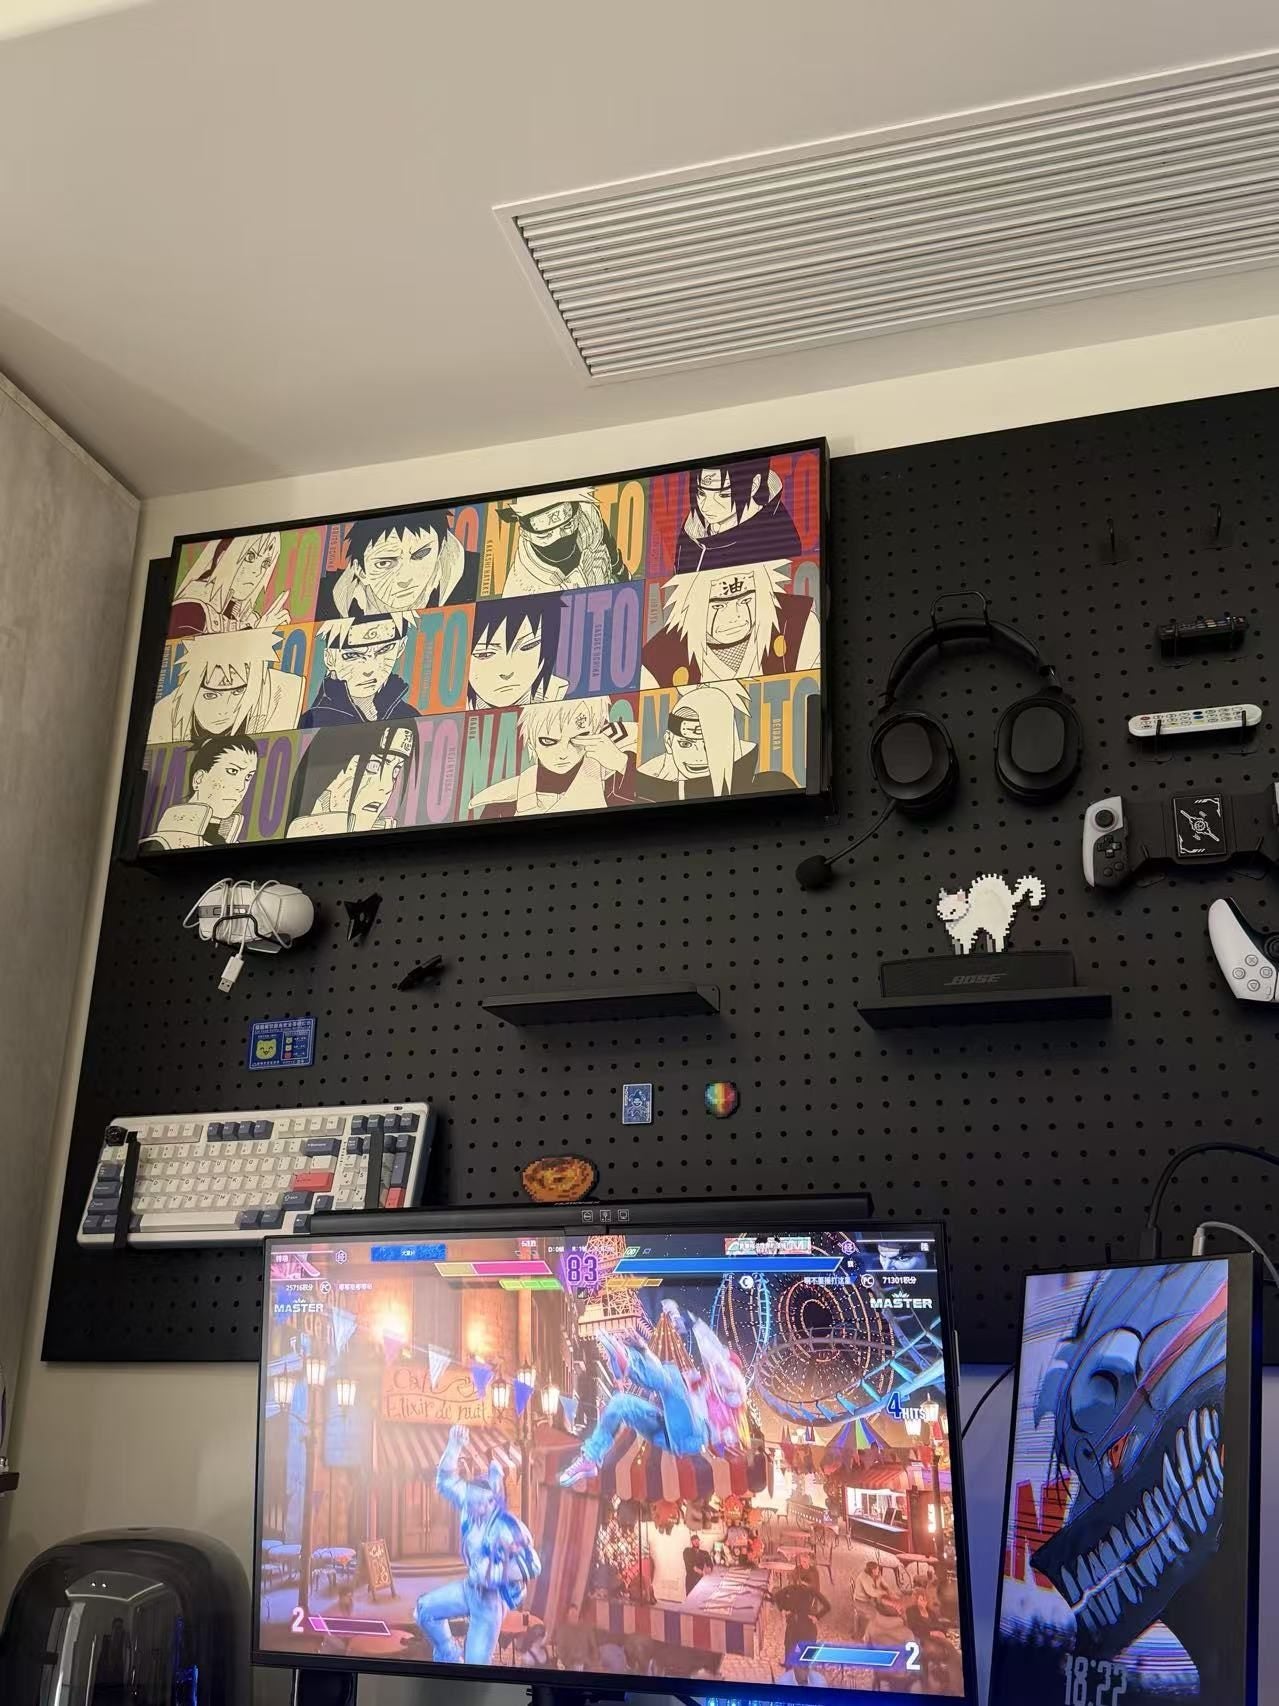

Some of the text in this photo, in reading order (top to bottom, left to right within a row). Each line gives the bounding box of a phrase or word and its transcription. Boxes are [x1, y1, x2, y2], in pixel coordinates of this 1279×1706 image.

[480, 540, 493, 595] KAKASHI HATAKE
[722, 576, 745, 596] 油
[593, 624, 602, 651] SASUKE
[468, 717, 478, 740] GAARA
[771, 718, 782, 750] DEIDARA
[949, 973, 1002, 985] BOSE
[566, 1254, 599, 1286] 83
[273, 1303, 324, 1313] MASTER
[869, 1298, 933, 1309] MASTER
[886, 1391, 927, 1420] 4 HITS
[290, 1606, 305, 1633] 2
[904, 1641, 921, 1670] 2
